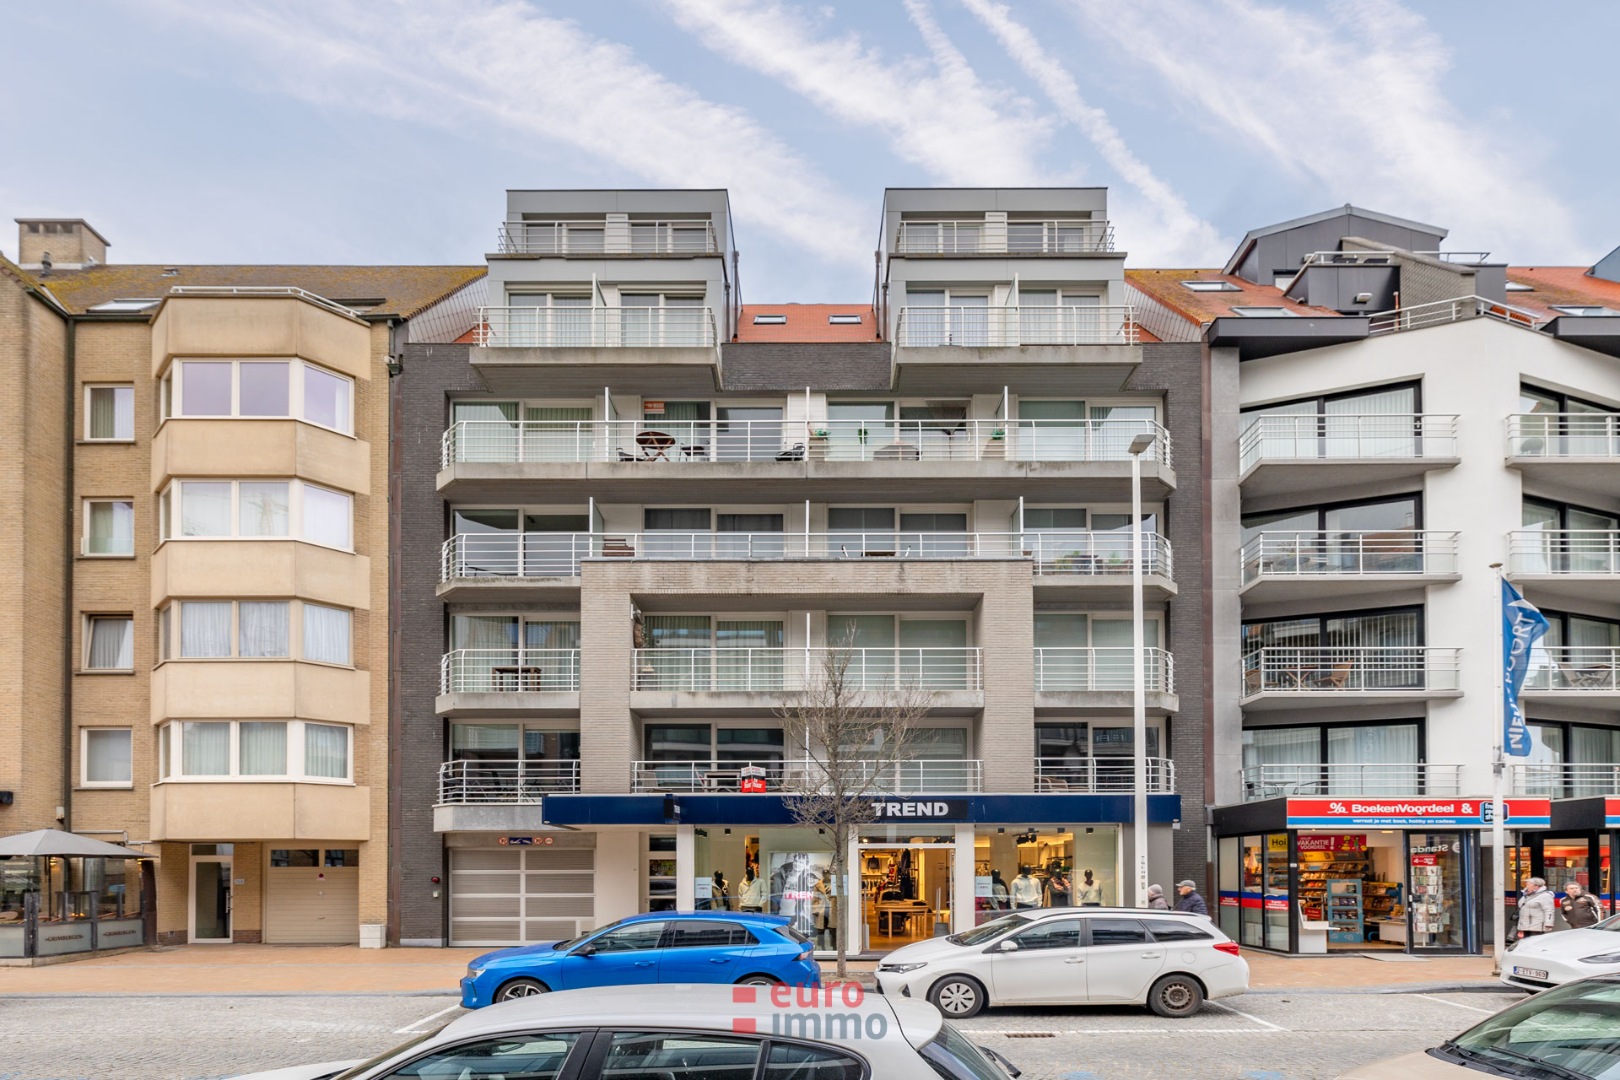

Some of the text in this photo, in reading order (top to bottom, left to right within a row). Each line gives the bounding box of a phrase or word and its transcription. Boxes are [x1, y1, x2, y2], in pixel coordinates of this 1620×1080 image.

[871, 802, 949, 816] TREND
[1351, 803, 1455, 814] BoekenVoordeel
[1461, 802, 1473, 814] &
[1271, 838, 1287, 846] Hoi
